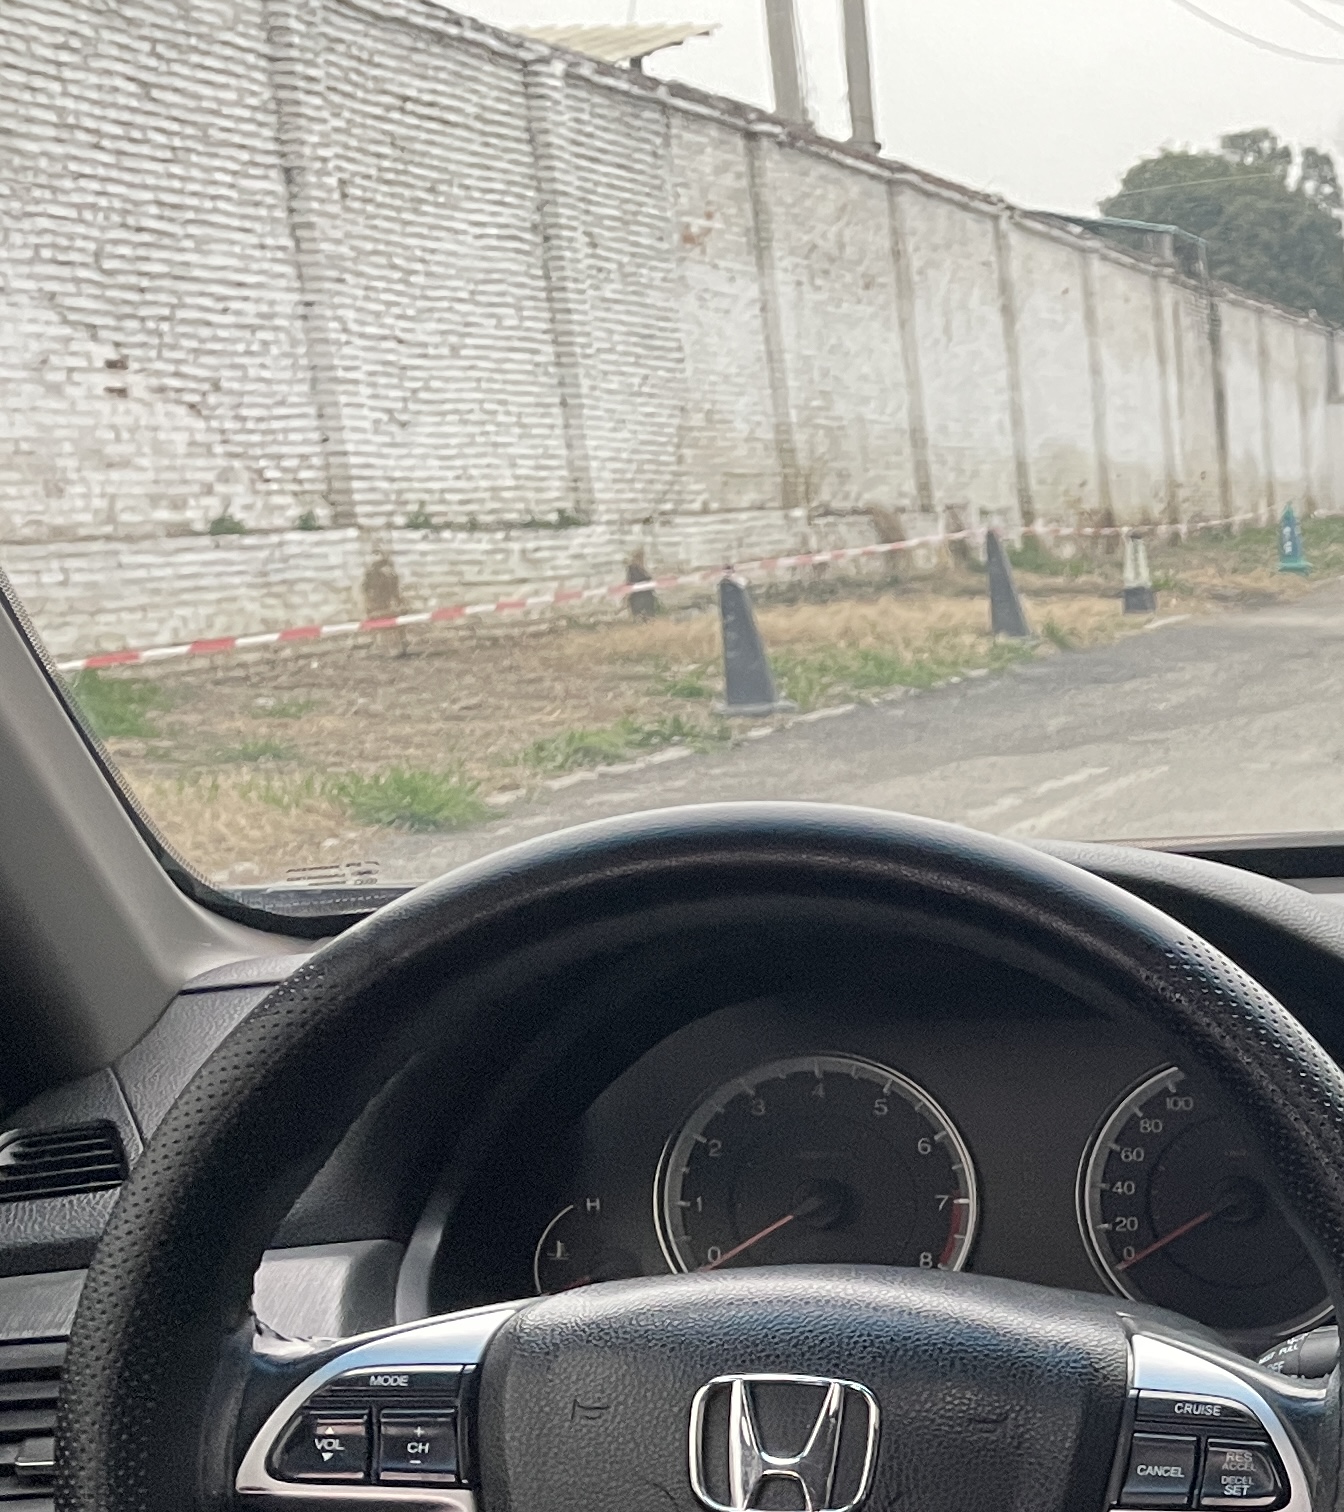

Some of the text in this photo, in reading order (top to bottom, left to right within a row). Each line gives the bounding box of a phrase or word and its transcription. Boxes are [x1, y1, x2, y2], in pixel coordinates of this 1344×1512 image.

[753, 1099, 766, 1116] 3
[874, 1099, 888, 1115] 5
[1166, 1097, 1194, 1111] 100
[1140, 1119, 1163, 1133] 80
[708, 1139, 722, 1157] 2
[917, 1138, 932, 1155] 6
[1120, 1148, 1145, 1162] 60
[1111, 1181, 1136, 1195] 40
[586, 1198, 600, 1211] H
[936, 1196, 949, 1211] 7
[1115, 1217, 1139, 1231] 20
[707, 1247, 722, 1264] 0
[919, 1252, 933, 1269] 8
[1123, 1247, 1135, 1261] 0
[369, 1375, 409, 1387] MODE
[1174, 1402, 1221, 1417] CRUISE
[314, 1438, 345, 1451] VOL
[406, 1442, 429, 1454] CH
[1225, 1452, 1253, 1463] RES
[1136, 1464, 1185, 1478] CANCEL
[1223, 1485, 1250, 1496] SET
